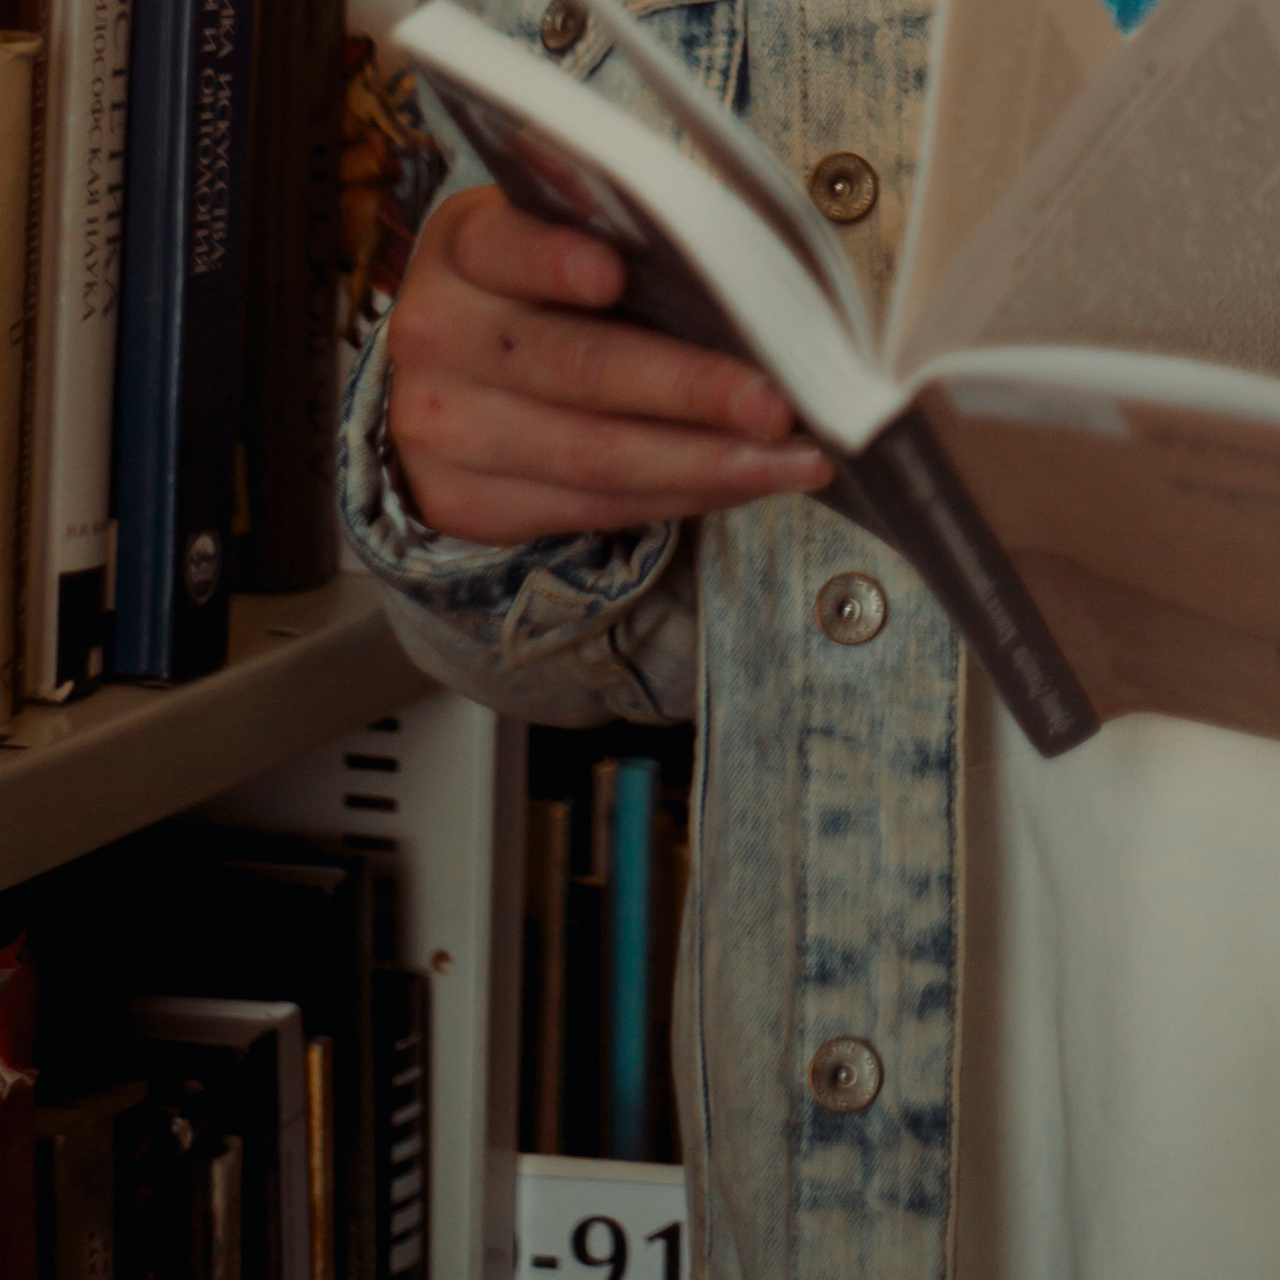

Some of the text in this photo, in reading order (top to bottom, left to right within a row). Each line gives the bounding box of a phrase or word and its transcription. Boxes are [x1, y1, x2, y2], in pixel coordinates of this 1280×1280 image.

[201, 26, 218, 53] И
[193, 67, 217, 277] ОНТОЛОГИЯ
[81, 216, 99, 323] НАУКА
